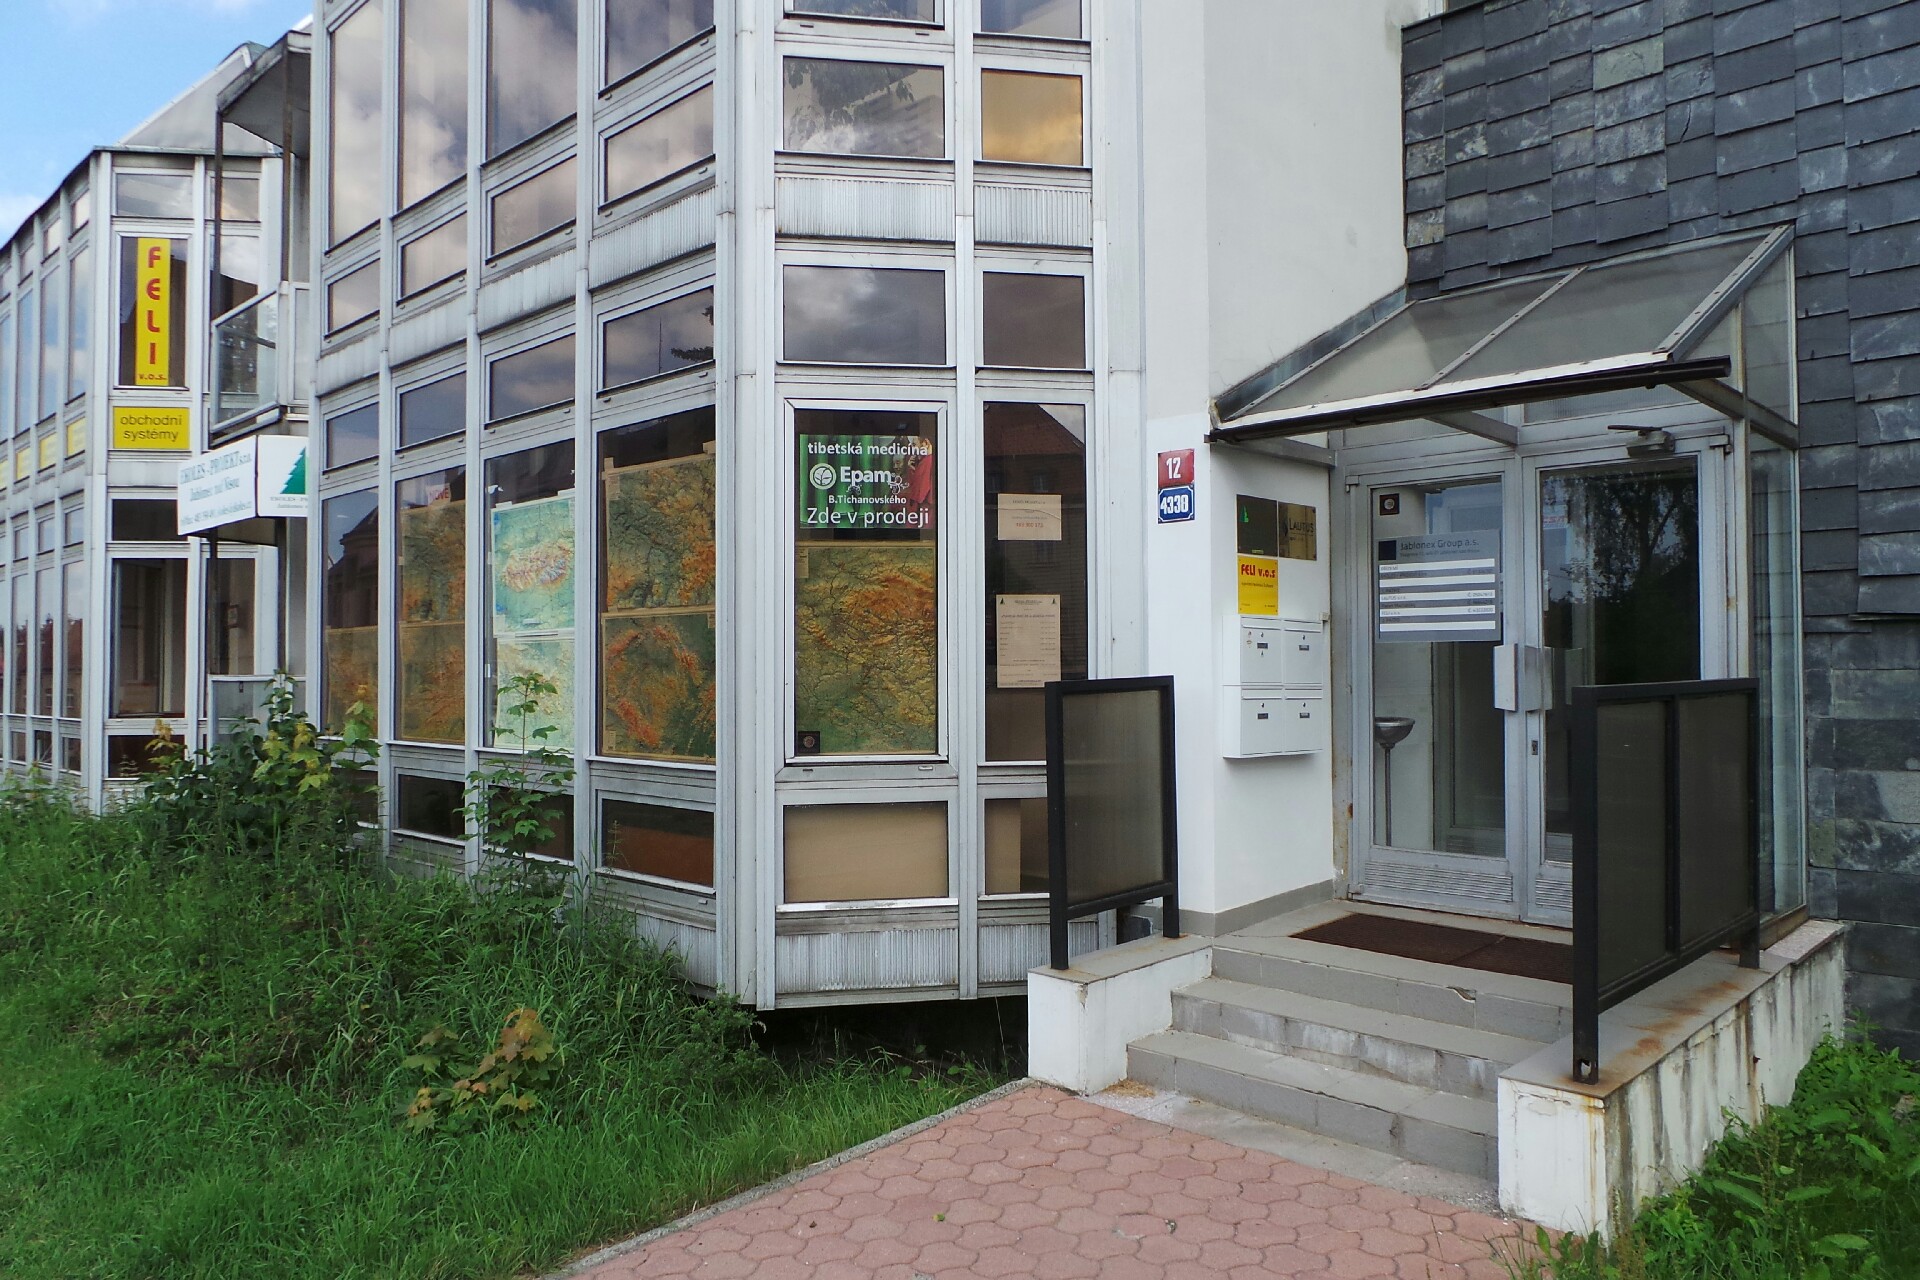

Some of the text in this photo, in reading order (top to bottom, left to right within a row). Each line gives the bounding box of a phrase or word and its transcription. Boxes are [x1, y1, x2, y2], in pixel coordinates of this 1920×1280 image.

[146, 246, 161, 365] FELI
[120, 414, 183, 426] obchodní
[123, 427, 180, 442] systémy
[807, 441, 928, 456] tibetská medicína
[1165, 457, 1182, 480] 12
[840, 465, 892, 488] Epam
[828, 494, 907, 505] B.Tichanovského
[807, 507, 929, 528] Zde v prodeji
[1400, 541, 1436, 551] Jablonex
[1437, 539, 1463, 549] Group
[1241, 563, 1256, 576] FELI
